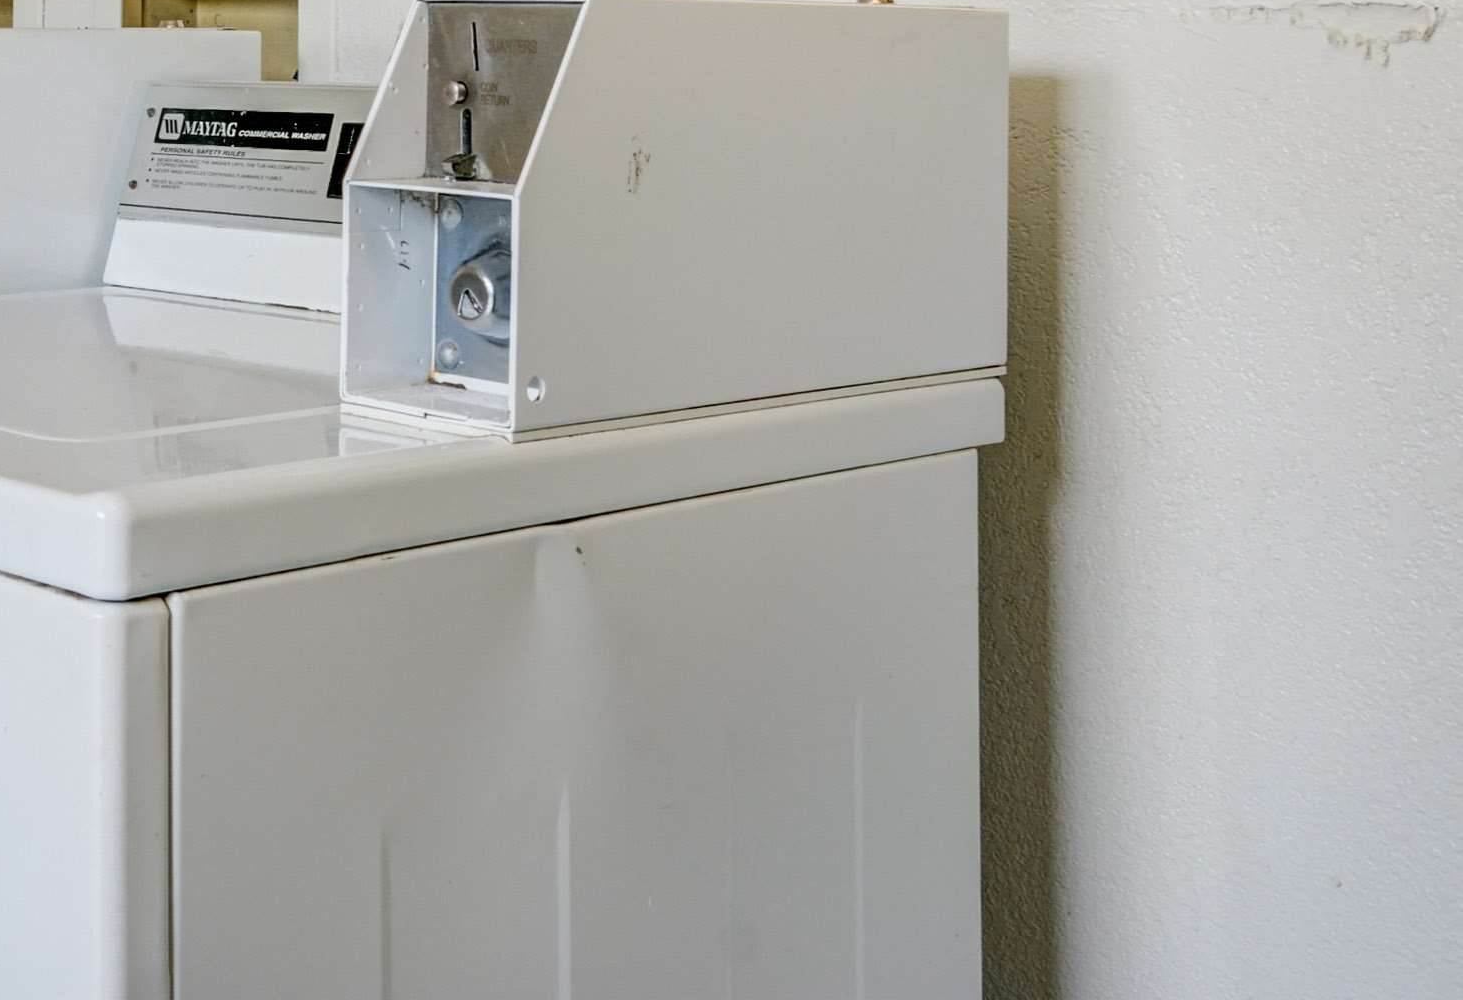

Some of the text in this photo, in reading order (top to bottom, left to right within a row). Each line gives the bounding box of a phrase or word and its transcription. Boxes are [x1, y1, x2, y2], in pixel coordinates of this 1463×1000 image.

[183, 120, 327, 142] MAYTAG COMMERCIAL WASHER
[161, 146, 245, 158] PERSONAL SAFETY RULES
